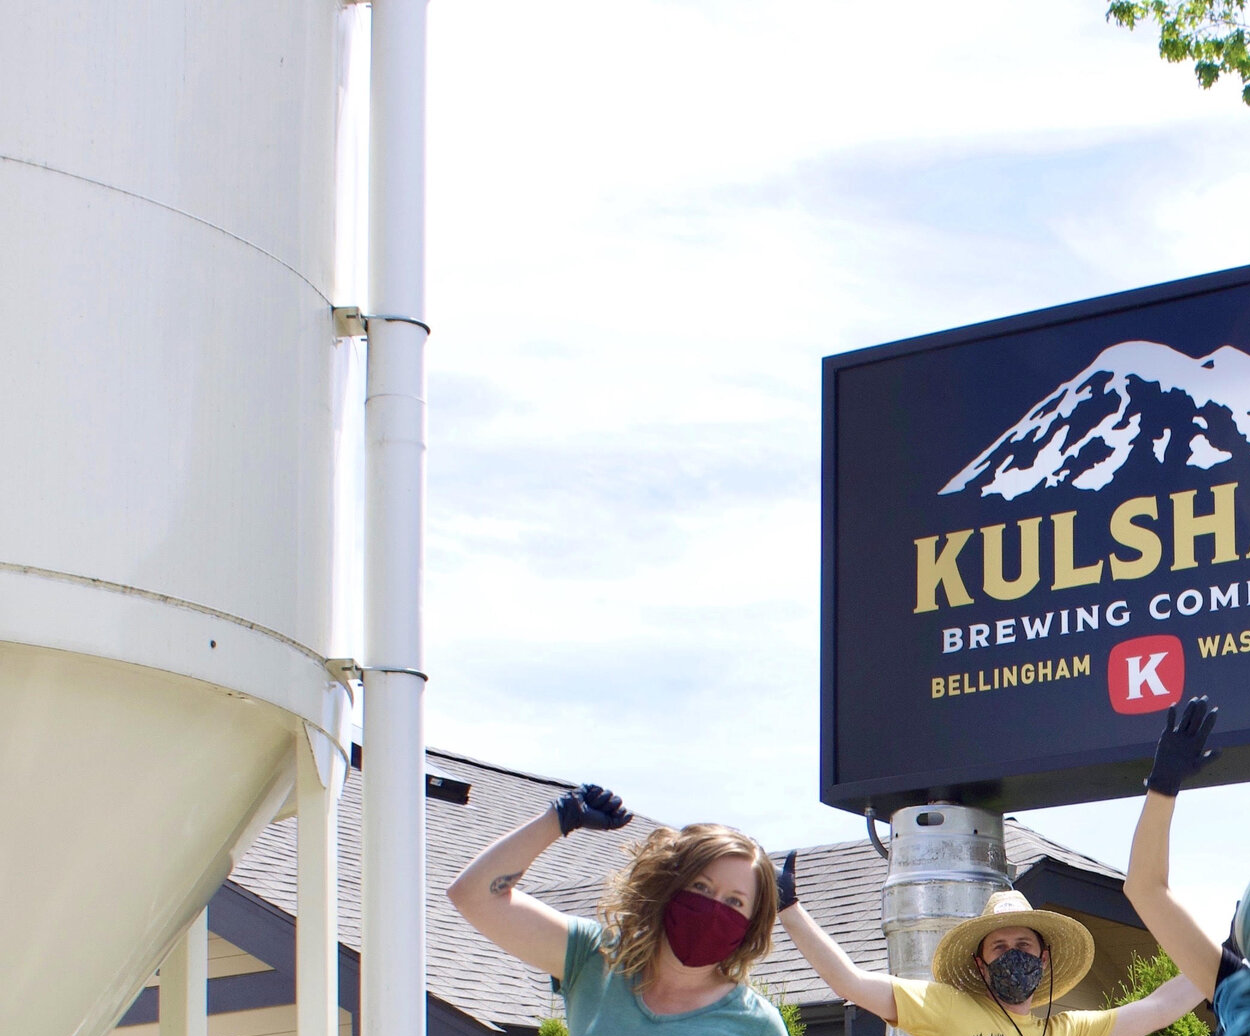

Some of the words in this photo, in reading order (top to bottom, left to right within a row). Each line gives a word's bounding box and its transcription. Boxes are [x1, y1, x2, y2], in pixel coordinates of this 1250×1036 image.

[942, 600, 1132, 654] BREWING
[931, 654, 1092, 699] BELLINGHAM
[1125, 651, 1171, 700] K
